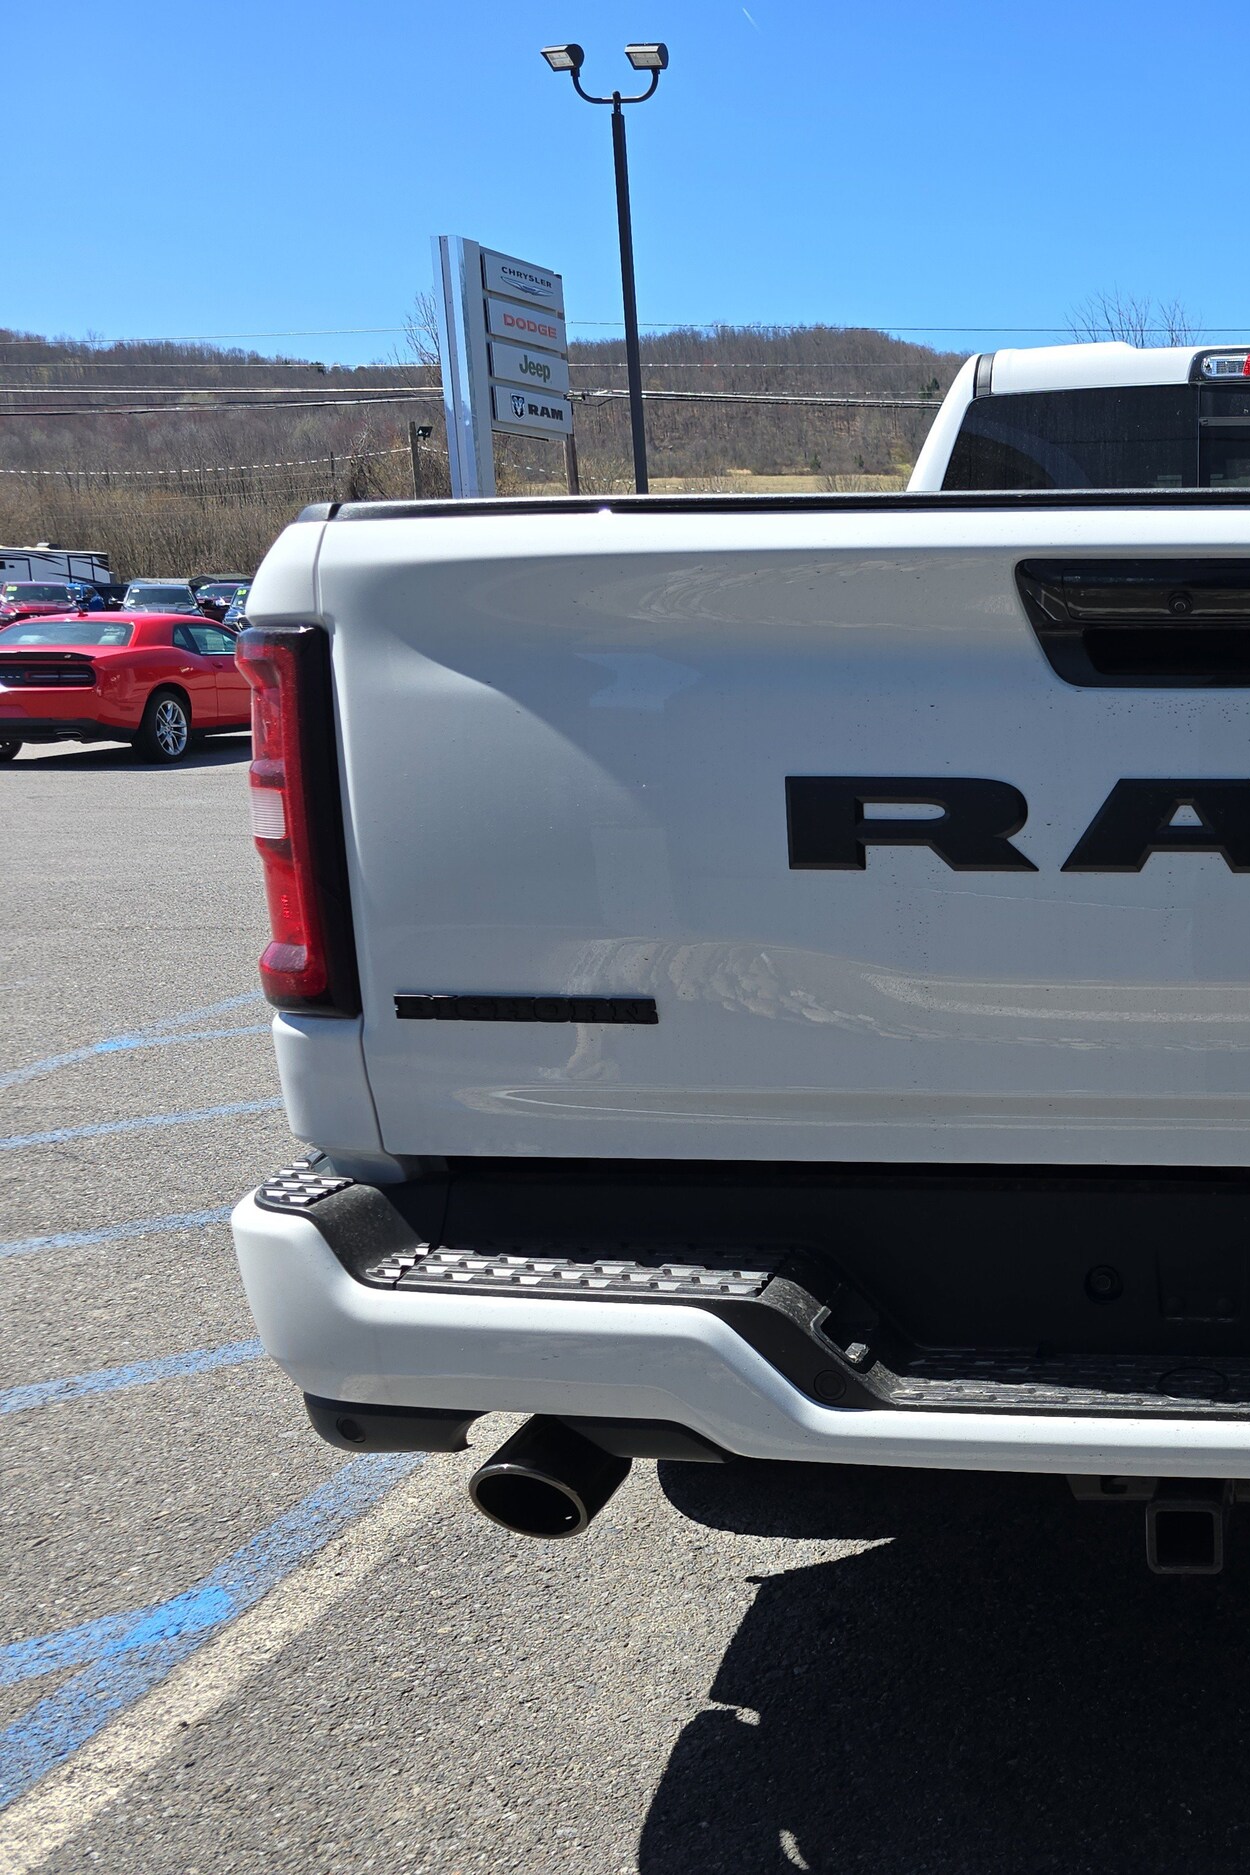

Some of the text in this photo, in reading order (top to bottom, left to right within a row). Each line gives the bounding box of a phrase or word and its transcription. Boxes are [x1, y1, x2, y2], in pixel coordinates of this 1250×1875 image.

[501, 266, 552, 288] CHRYSLER
[503, 313, 557, 339] DODGE
[519, 355, 550, 383] Jeep
[528, 404, 564, 421] RAM
